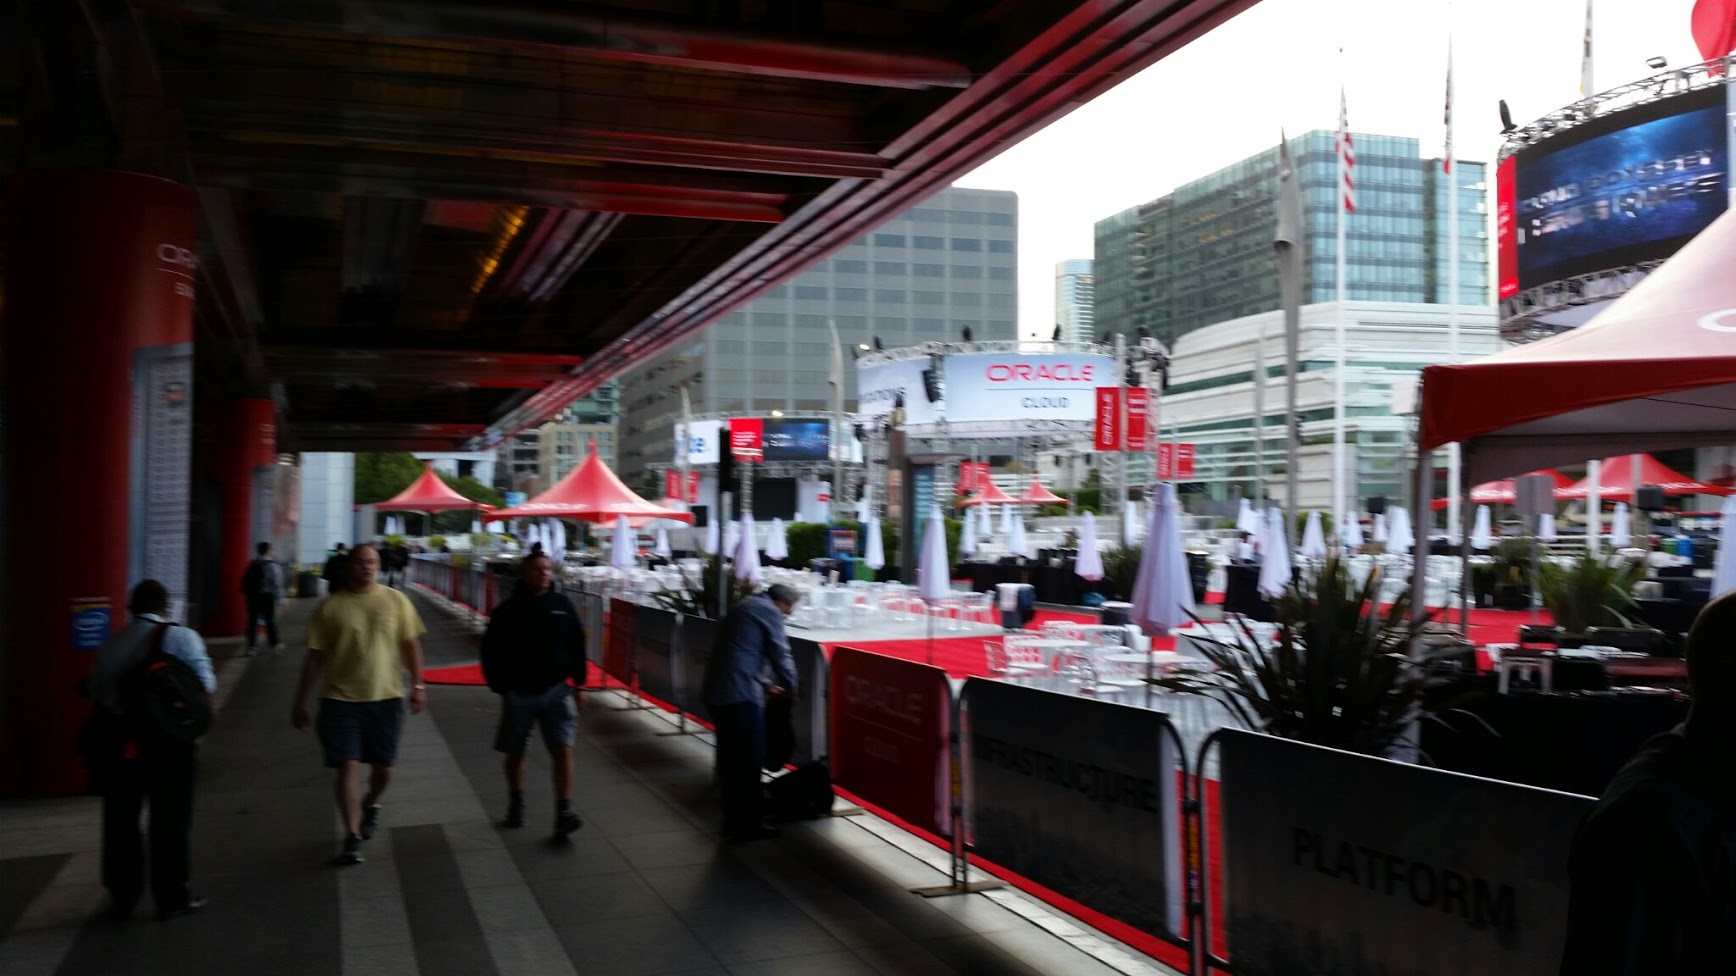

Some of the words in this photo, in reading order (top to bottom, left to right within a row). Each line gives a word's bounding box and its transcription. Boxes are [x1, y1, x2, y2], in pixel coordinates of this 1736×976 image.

[985, 363, 1095, 382] ORACLE
[1021, 396, 1071, 409] CLOUD
[1293, 827, 1516, 936] PLATFORM
